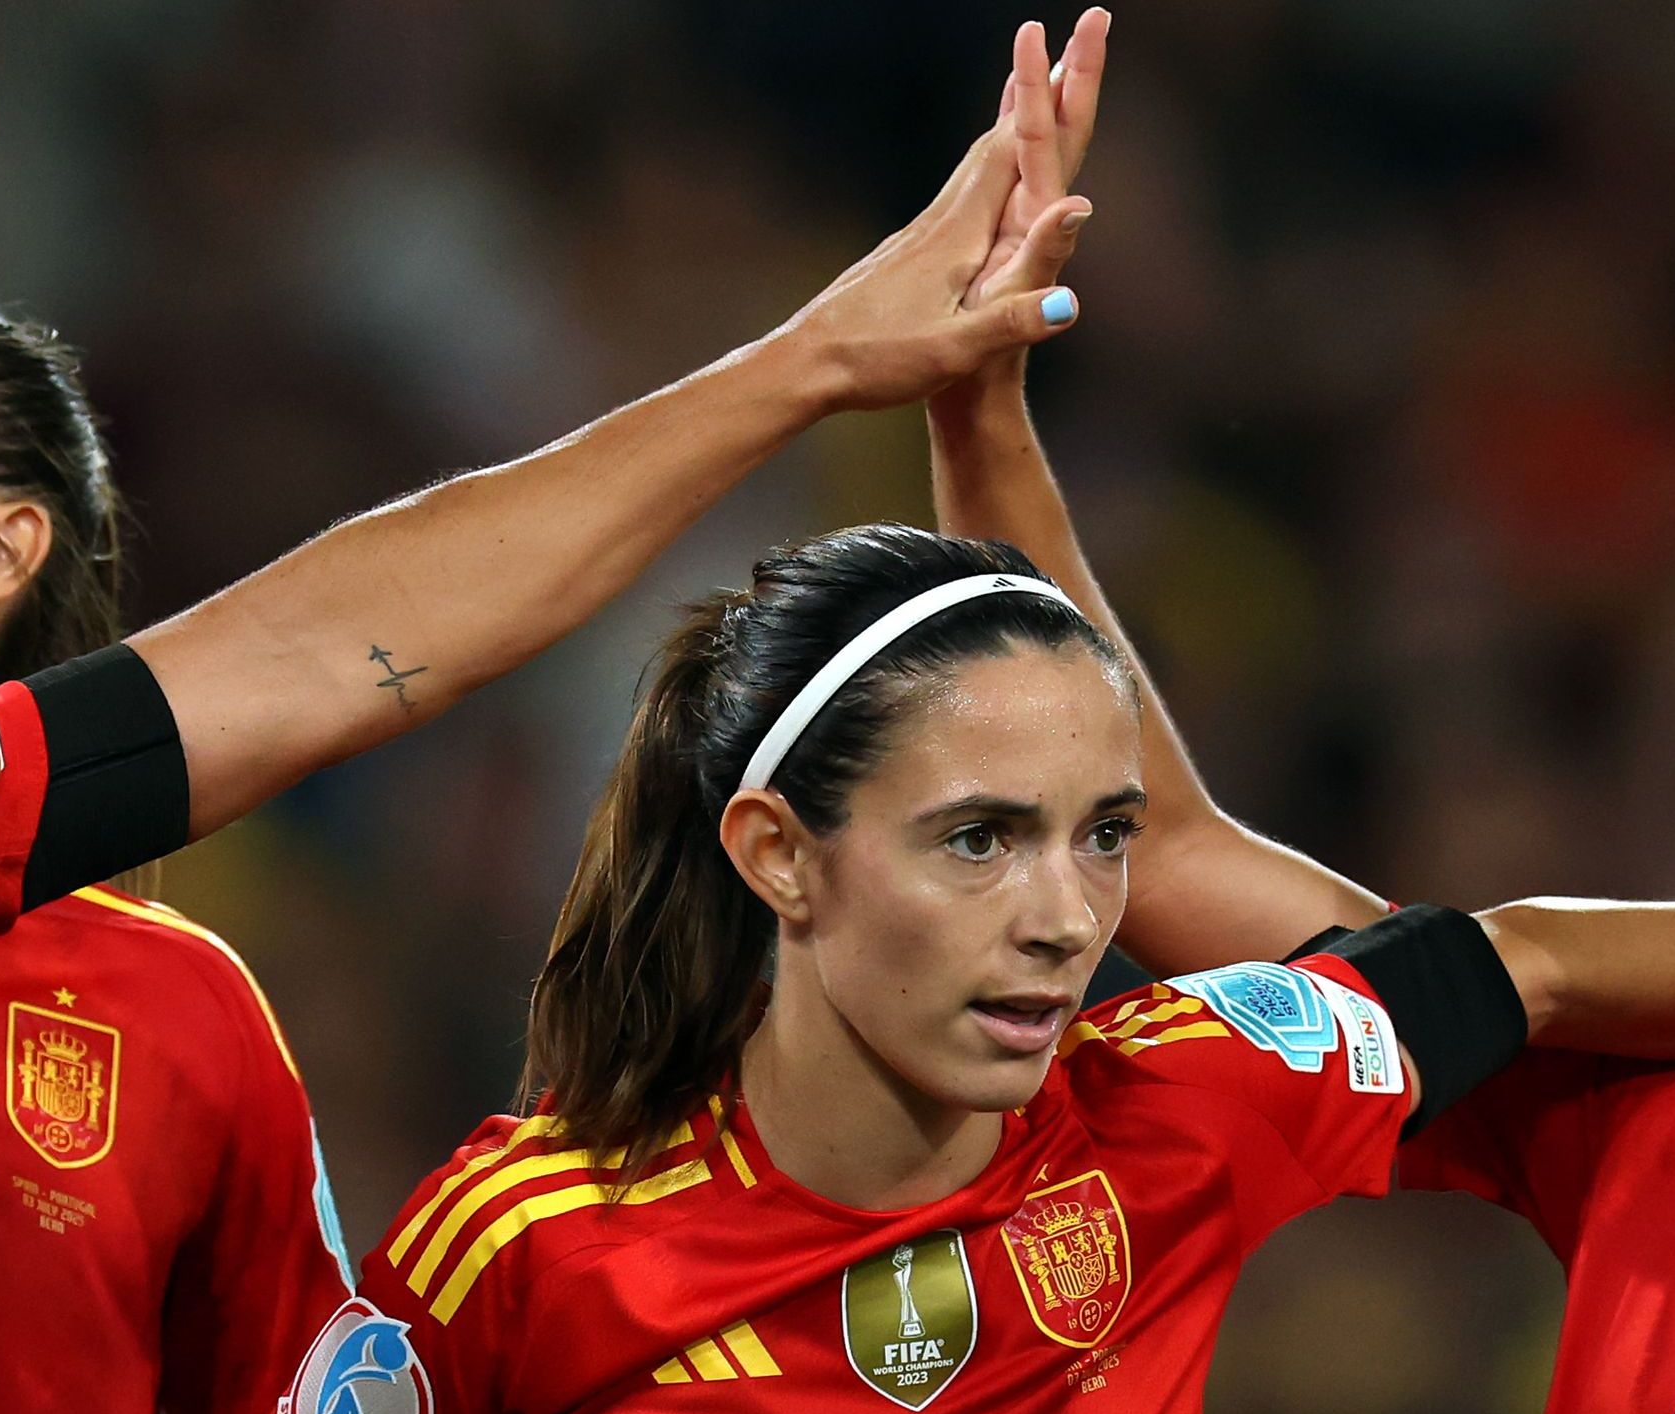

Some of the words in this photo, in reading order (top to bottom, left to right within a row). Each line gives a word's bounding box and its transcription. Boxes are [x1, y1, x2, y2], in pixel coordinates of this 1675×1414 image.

[1353, 1044, 1365, 1086] UEFA
[884, 1340, 942, 1366] FIFA
[873, 1365, 904, 1376] WORLD
[905, 1358, 954, 1372] CHAMPIONS
[896, 1371, 929, 1387] 2023
[1081, 1375, 1107, 1394] BERN
